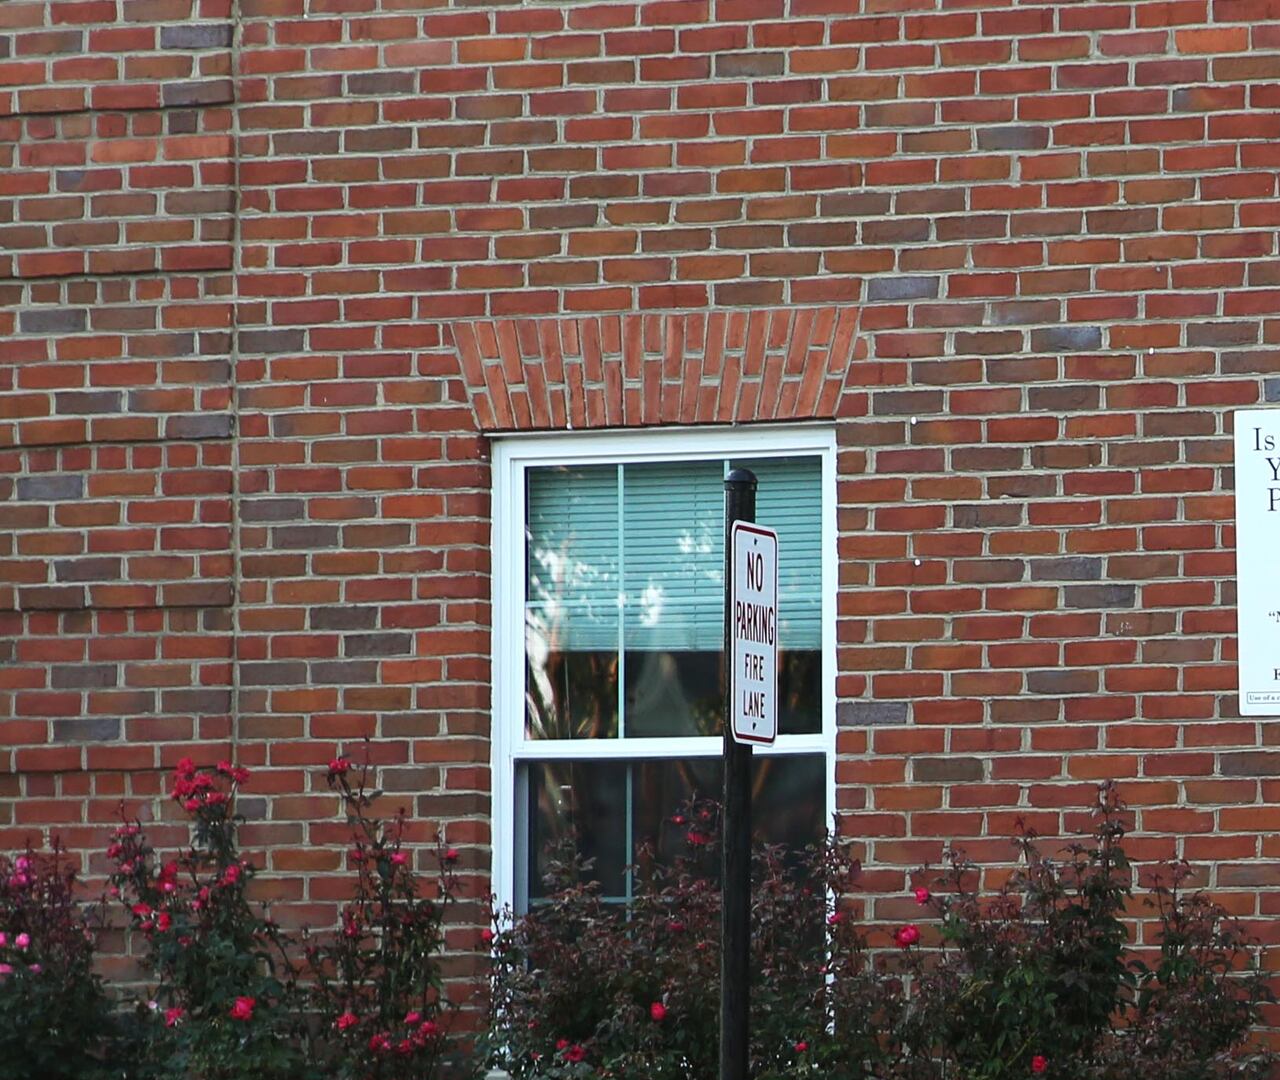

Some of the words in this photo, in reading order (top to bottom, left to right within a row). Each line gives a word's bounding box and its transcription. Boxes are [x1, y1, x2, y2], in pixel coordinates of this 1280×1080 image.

[1253, 427, 1275, 451] Is
[747, 551, 763, 592] NO
[737, 601, 774, 645] PARKING
[745, 653, 764, 681] FIRE
[743, 690, 765, 719] LANE
